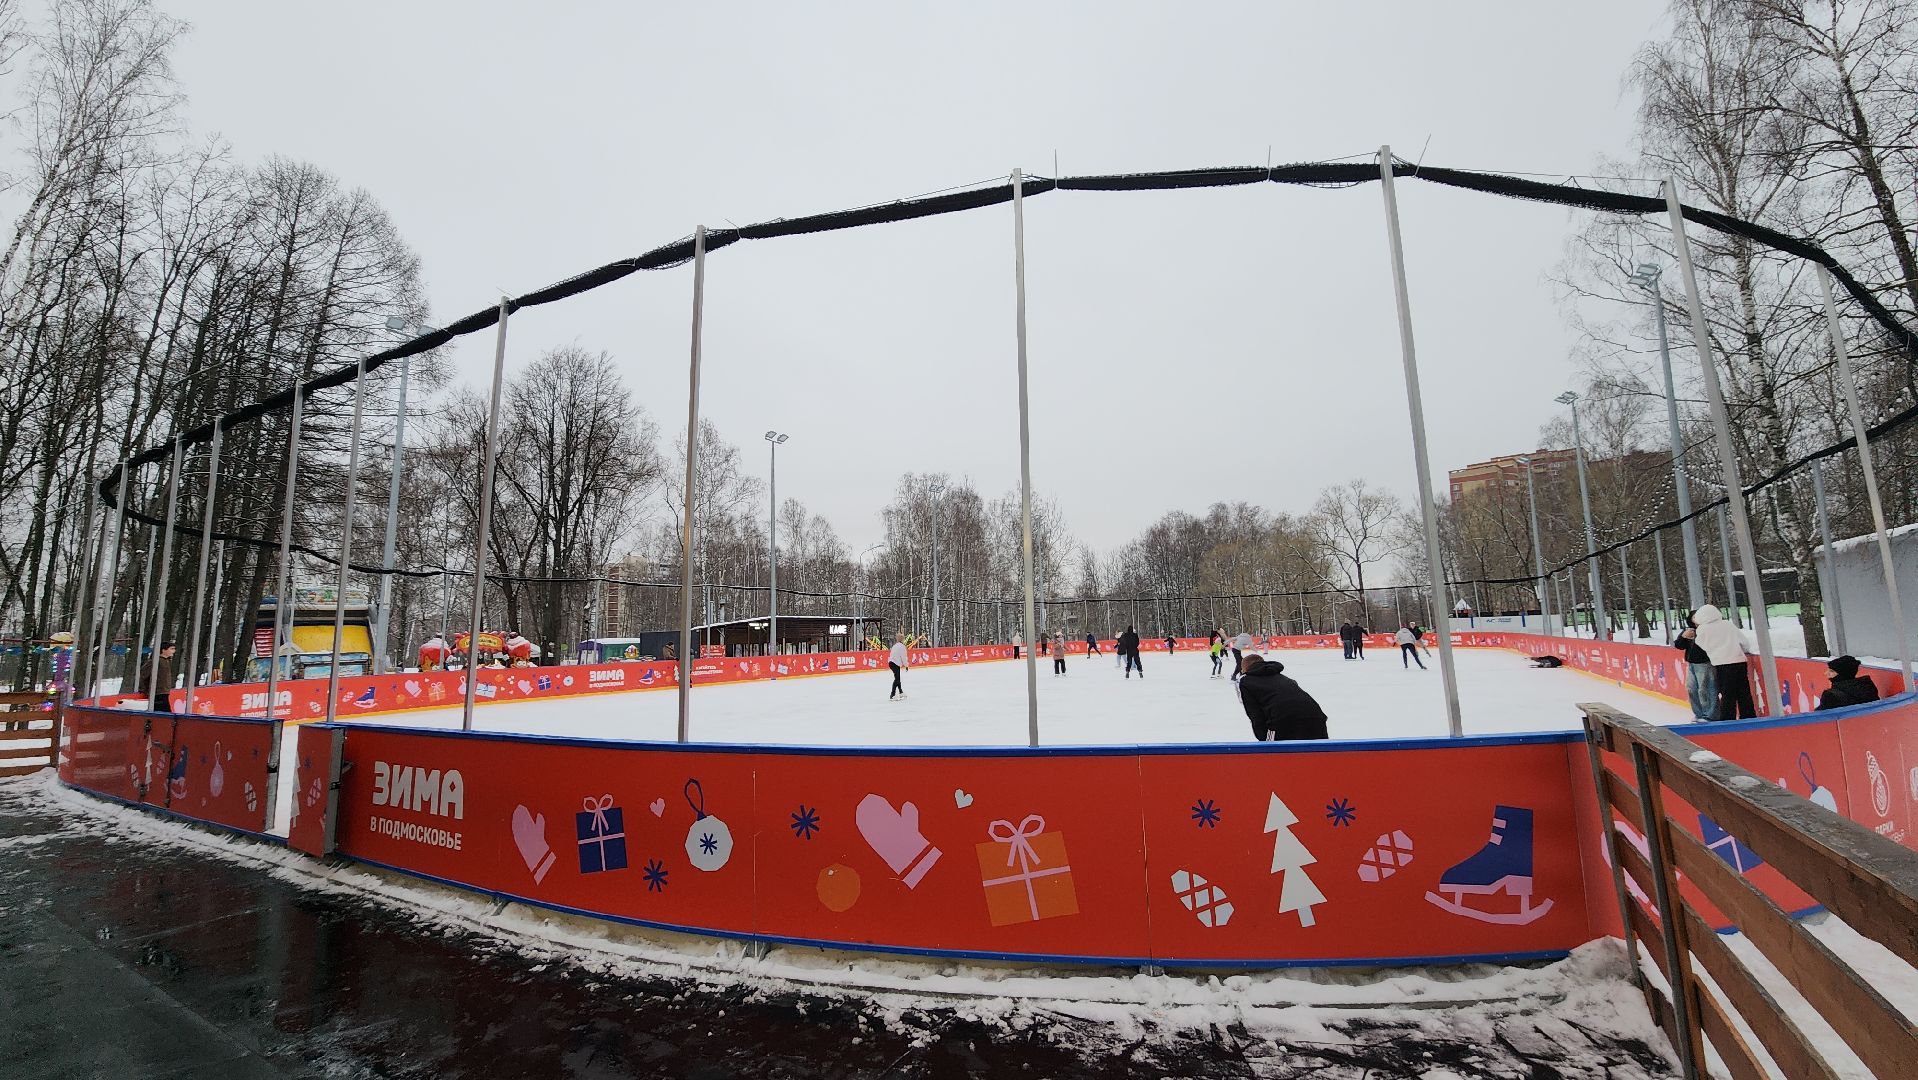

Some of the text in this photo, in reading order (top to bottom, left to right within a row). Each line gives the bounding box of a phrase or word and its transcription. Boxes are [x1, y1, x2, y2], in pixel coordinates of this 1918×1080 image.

[829, 624, 847, 635] КАФЕ
[589, 668, 624, 682] ЗИМА
[372, 760, 464, 820] ЗИМА
[370, 815, 462, 851] В ПОДМОСКОВЬЕ
